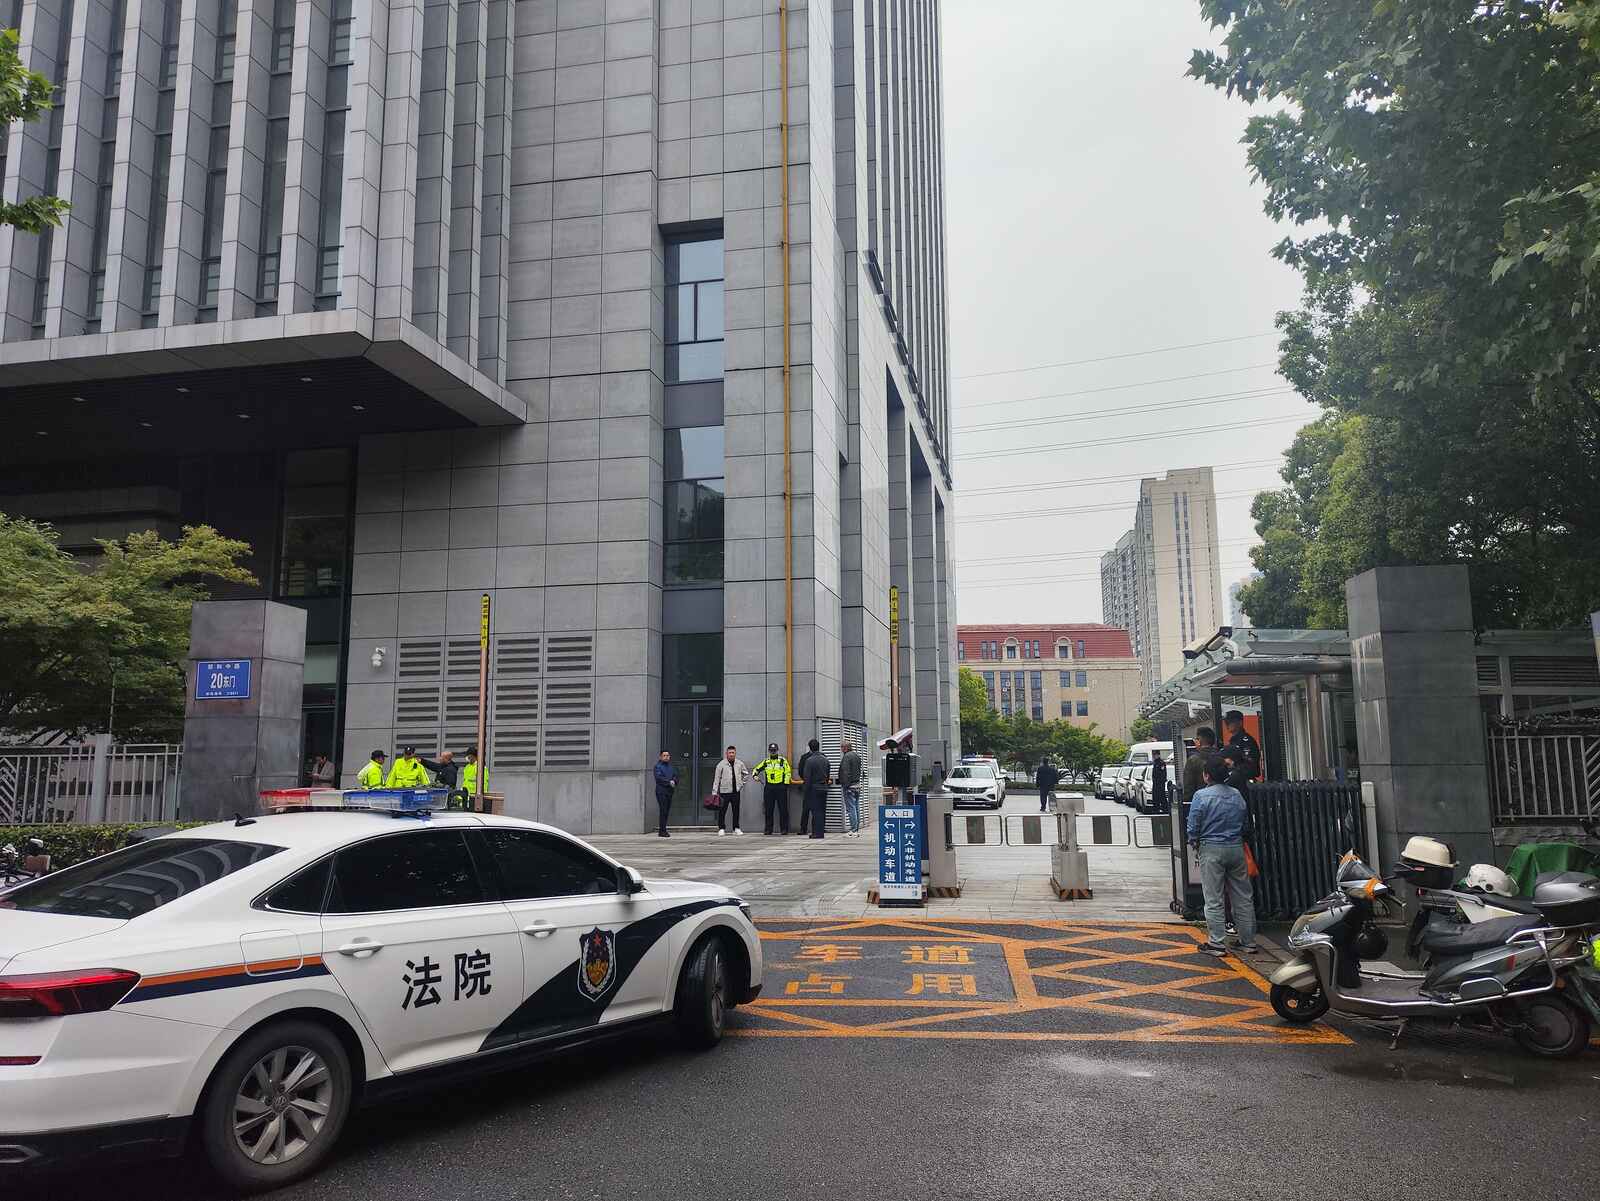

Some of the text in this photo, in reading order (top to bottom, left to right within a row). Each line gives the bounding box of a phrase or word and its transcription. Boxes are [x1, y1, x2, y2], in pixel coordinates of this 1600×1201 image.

[210, 672, 236, 689] 20东门
[884, 833, 896, 882] 机动车道
[904, 833, 916, 882] 行人非机动车道
[794, 943, 976, 965] 车道
[401, 949, 493, 1011] 法院
[784, 972, 978, 996] 占用
